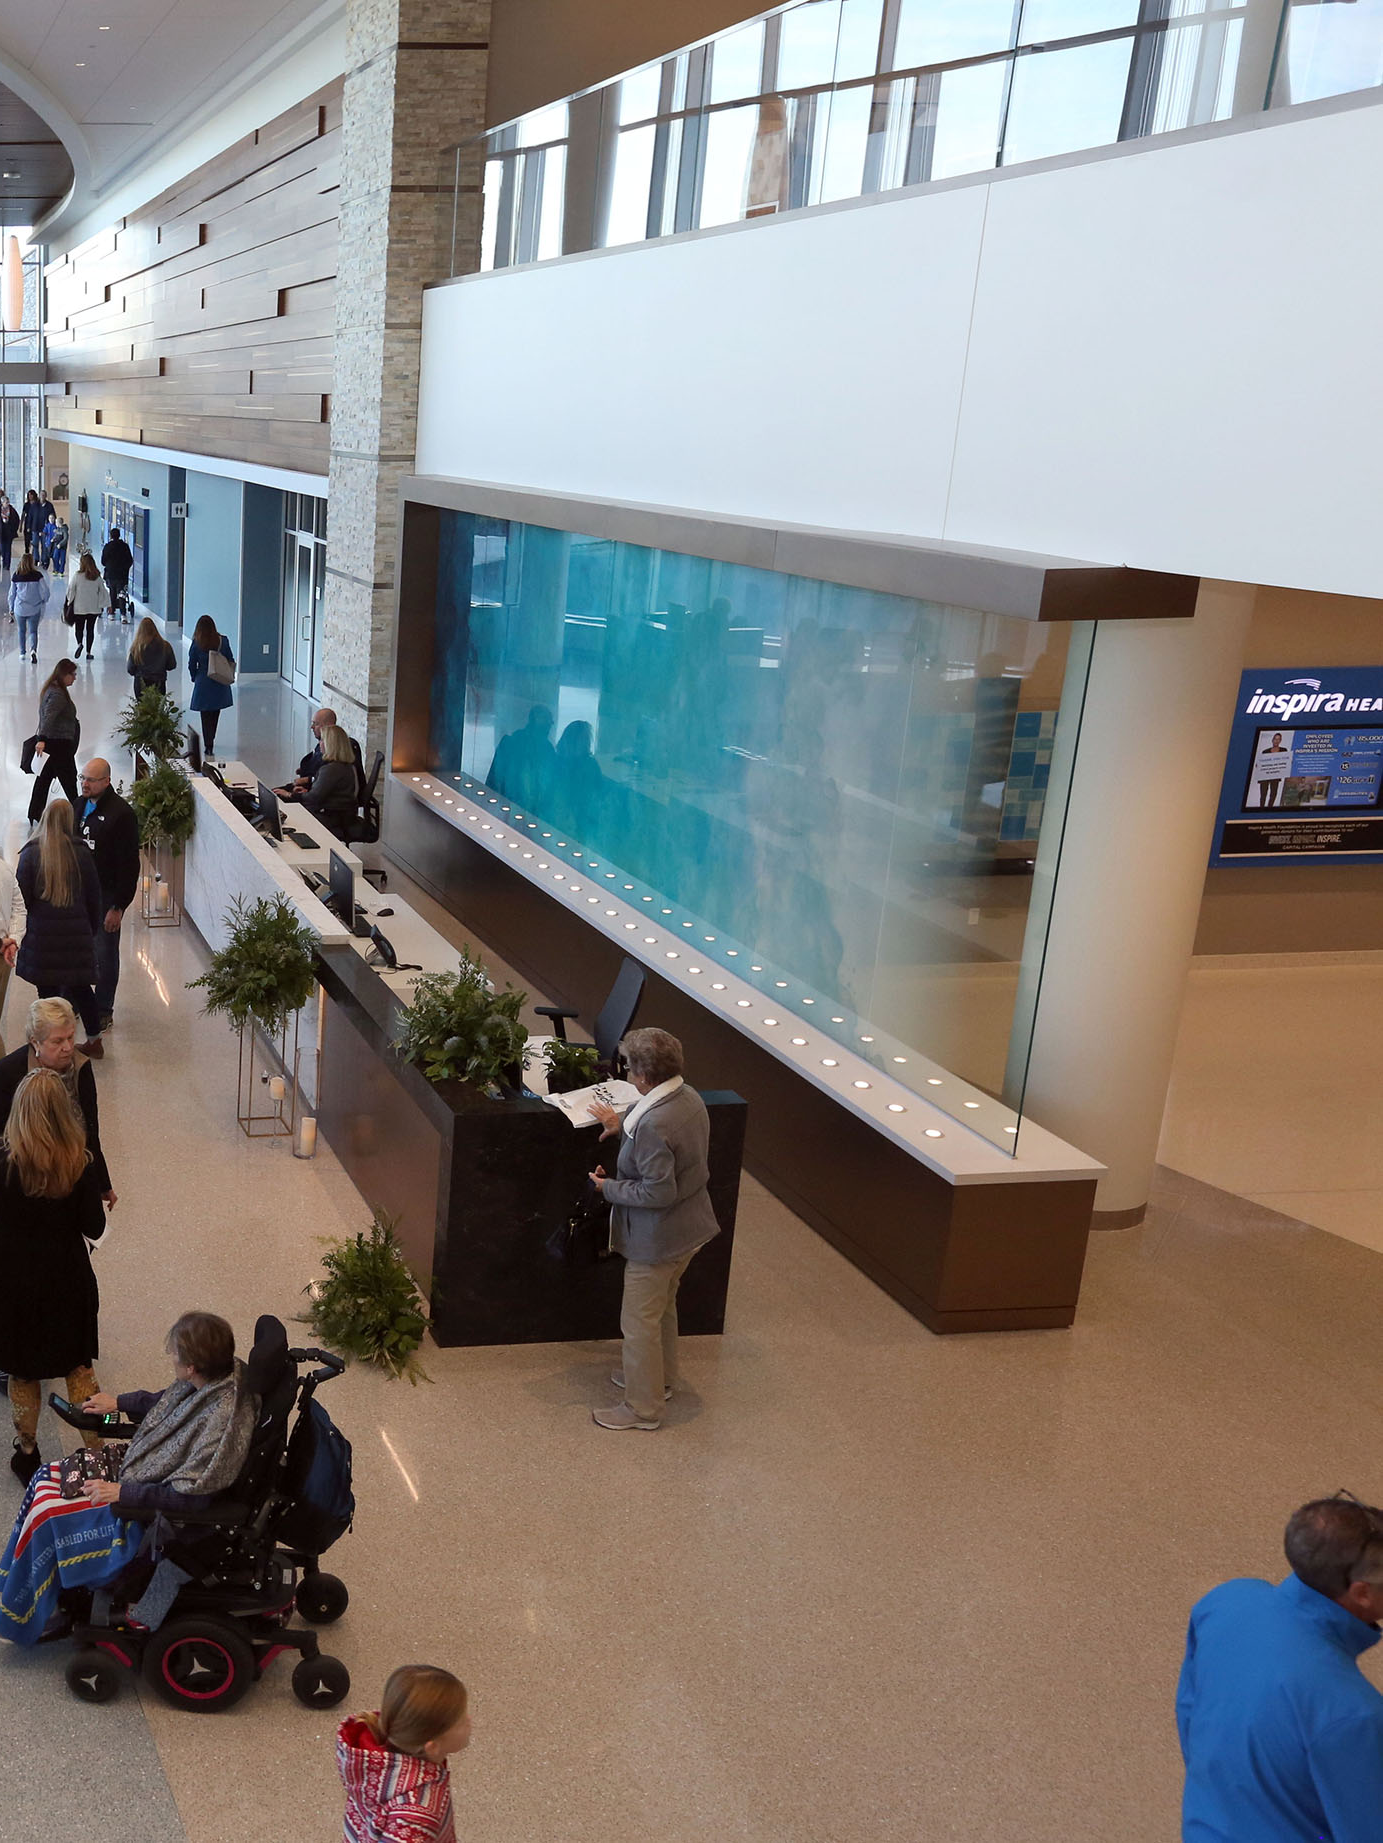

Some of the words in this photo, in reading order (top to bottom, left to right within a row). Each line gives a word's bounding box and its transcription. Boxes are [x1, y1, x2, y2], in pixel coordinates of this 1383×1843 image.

[1245, 688, 1345, 721] inspira
[1344, 697, 1383, 712] HEA
[83, 1528, 99, 1542] FOR
